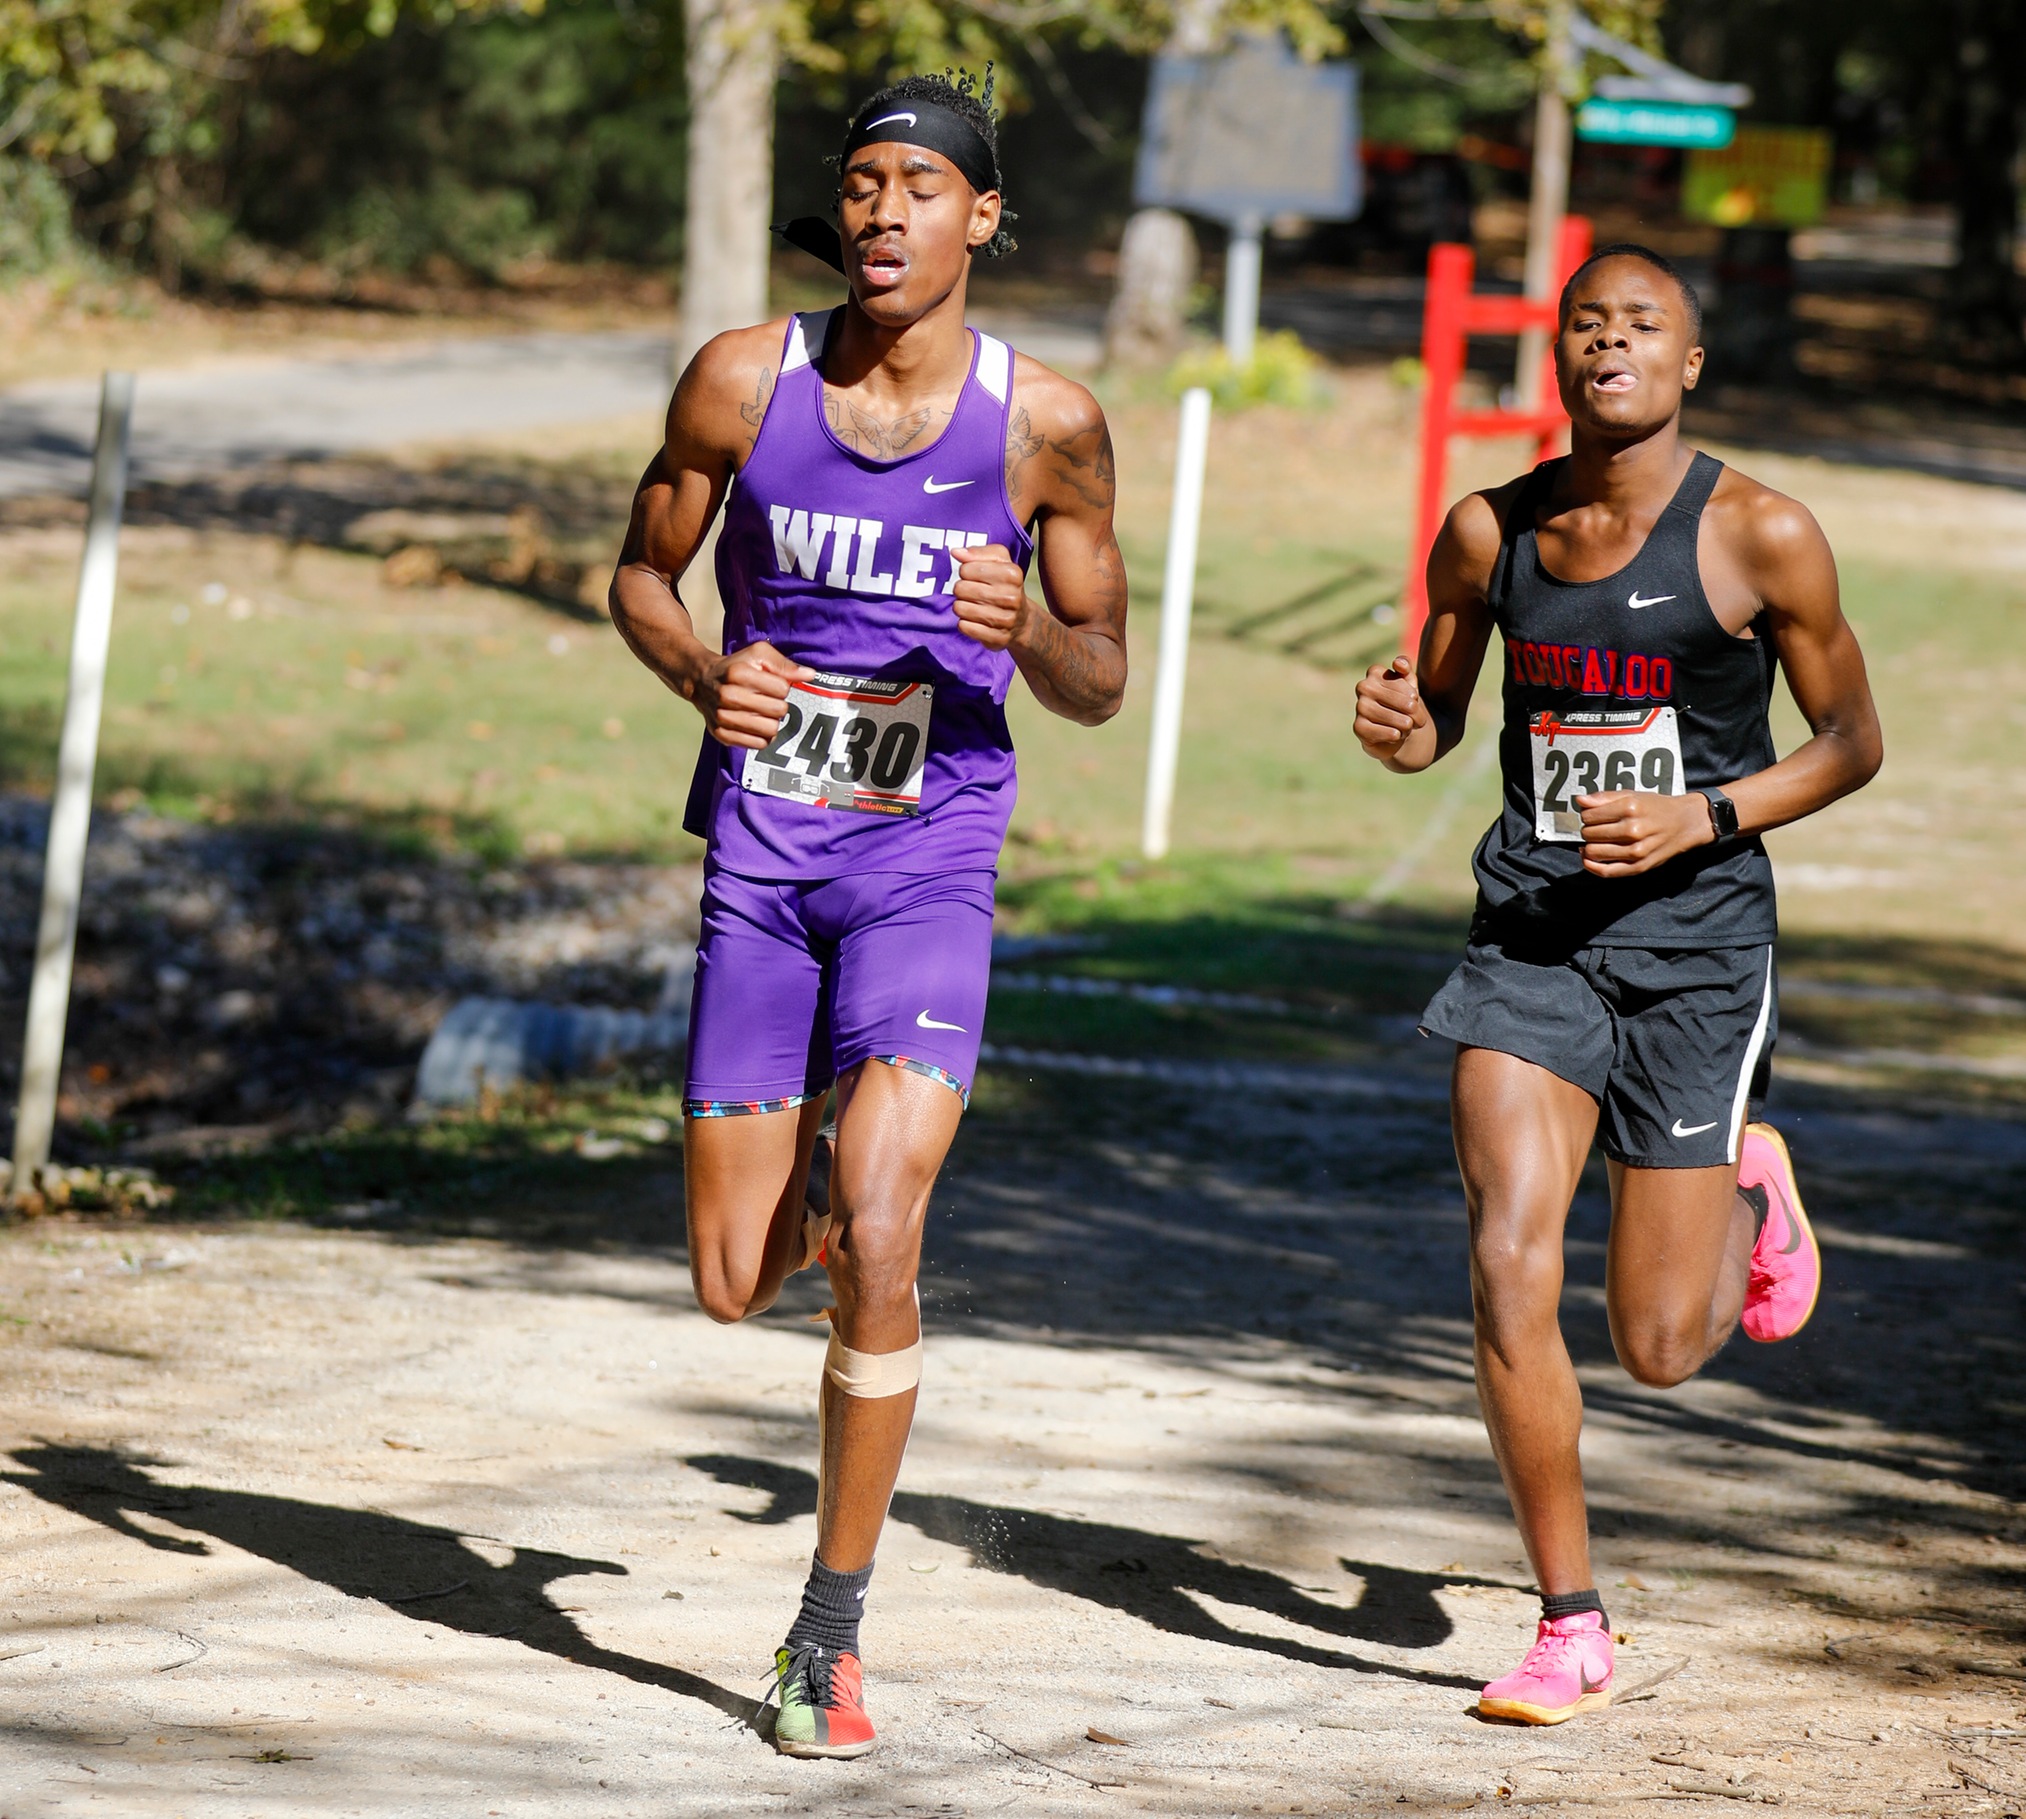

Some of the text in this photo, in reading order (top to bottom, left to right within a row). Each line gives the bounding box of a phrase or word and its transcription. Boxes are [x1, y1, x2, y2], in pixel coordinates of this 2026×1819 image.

[769, 504, 988, 598] WILEY
[814, 672, 898, 692] PRESS TIMING
[1507, 638, 1674, 701] TOUGALOO
[754, 702, 921, 789] 2430
[1564, 711, 1642, 723] XPRESS TIMING
[1542, 747, 1675, 813] 2369
